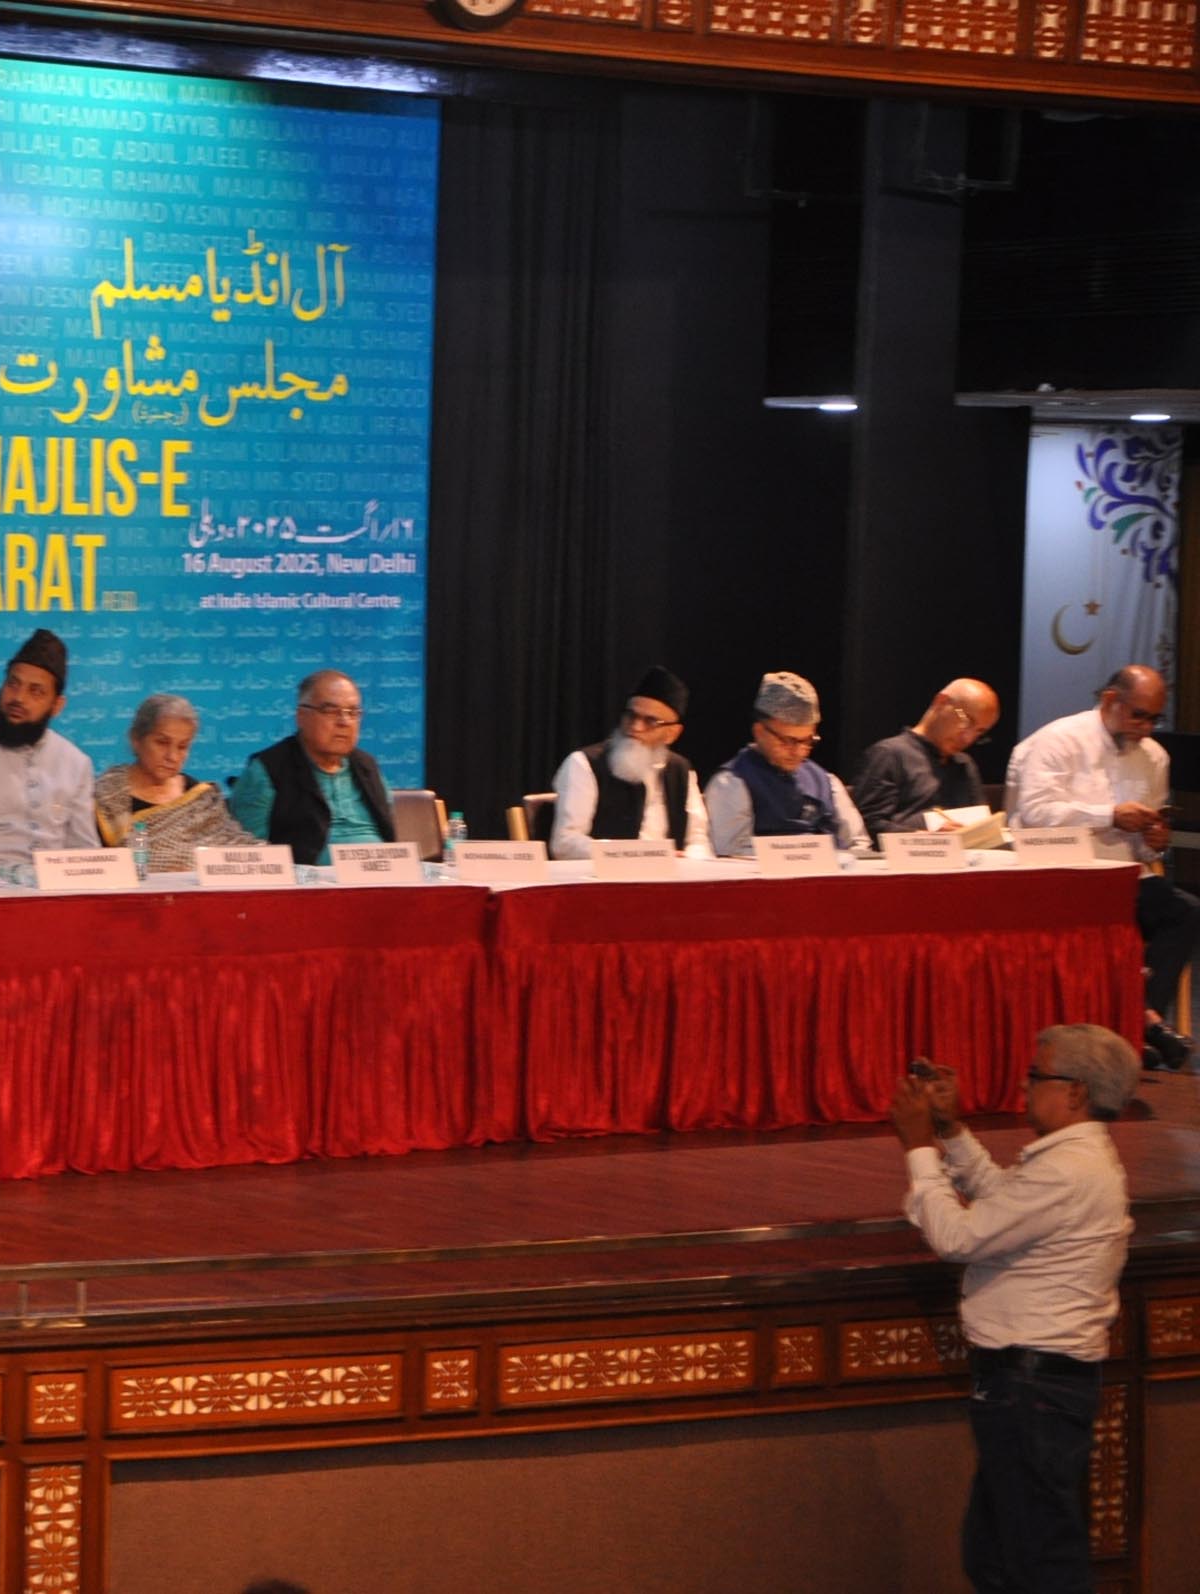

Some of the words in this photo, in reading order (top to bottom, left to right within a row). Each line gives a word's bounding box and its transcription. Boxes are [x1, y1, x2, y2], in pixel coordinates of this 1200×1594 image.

[19, 101, 147, 132] MOHAMMAD
[112, 139, 178, 165] ABDUL
[42, 195, 168, 223] MOHAMMAD
[90, 237, 203, 341] مسلم
[198, 338, 349, 427] مجلس
[182, 552, 206, 574] 16
[206, 552, 273, 579] August
[275, 552, 324, 577] 2025,
[326, 552, 368, 574] New
[368, 551, 417, 574] Delhi
